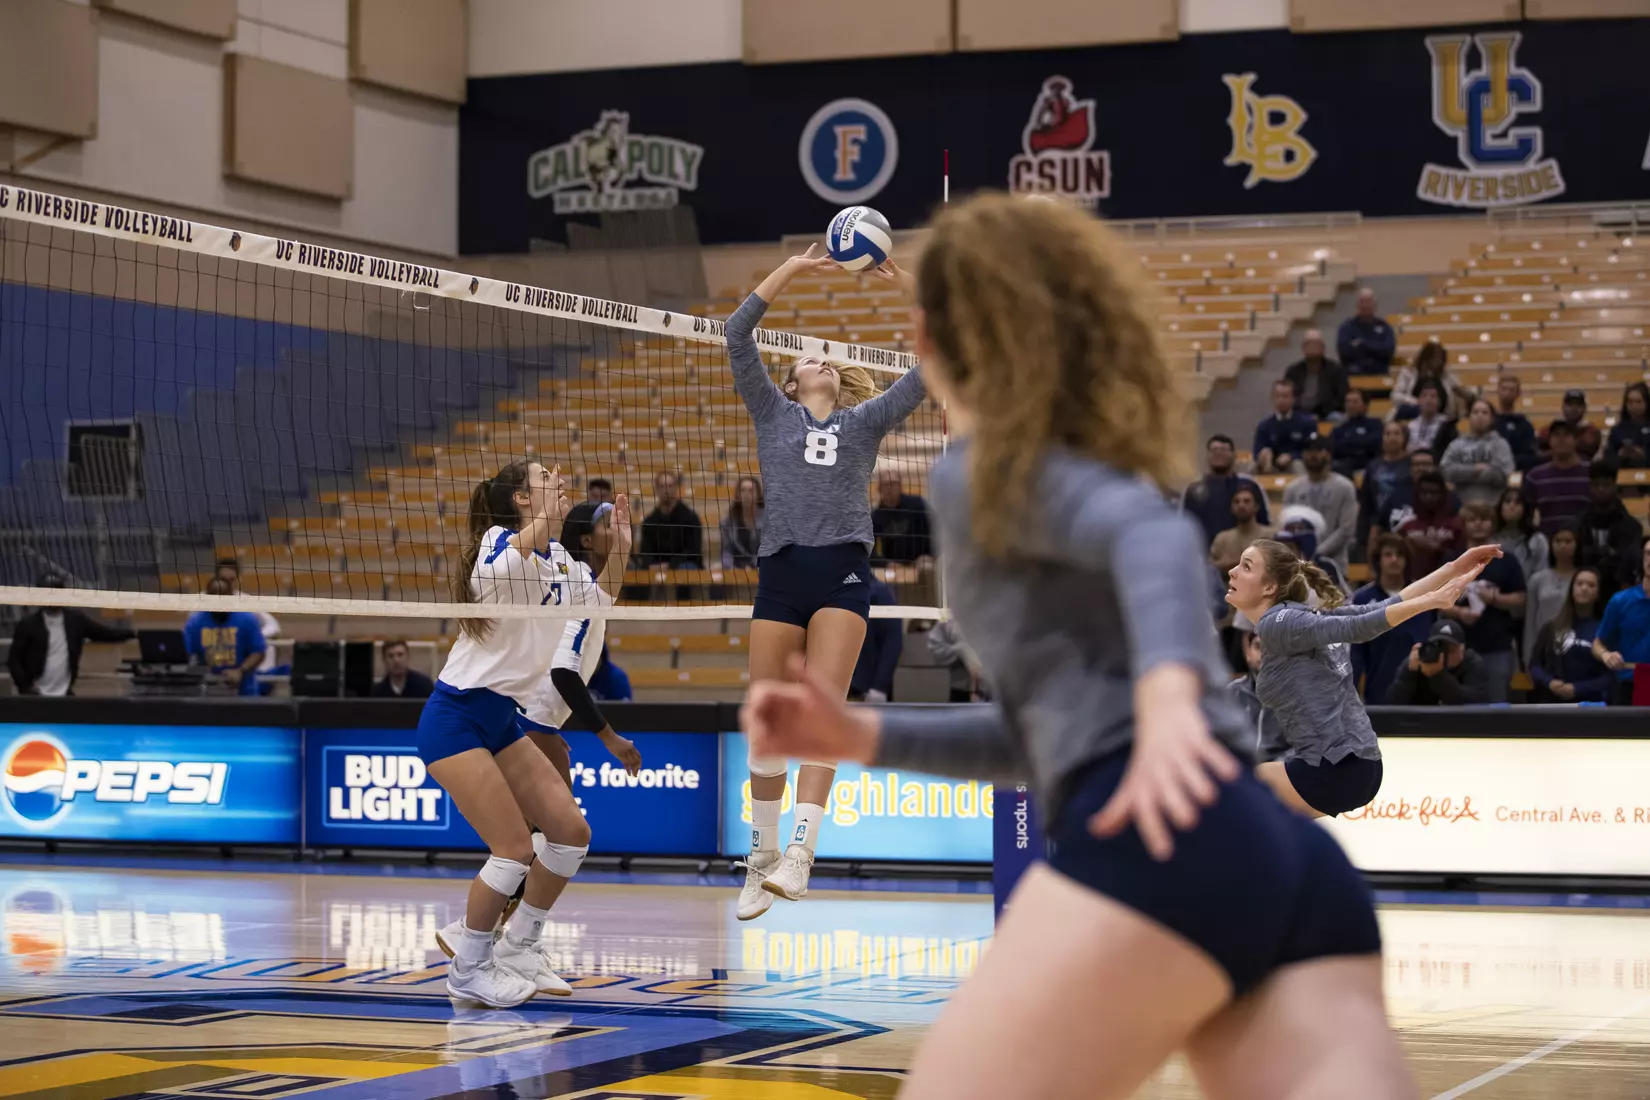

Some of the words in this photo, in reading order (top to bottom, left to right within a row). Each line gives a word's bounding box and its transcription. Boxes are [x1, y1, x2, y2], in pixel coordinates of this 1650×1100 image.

[532, 147, 587, 192] CAL
[627, 139, 698, 183] POLY
[832, 124, 868, 181] F
[1014, 156, 1104, 194] CSUN
[1423, 165, 1560, 201] RIVERSIDE
[16, 189, 99, 226] RIVERSIDE
[104, 206, 193, 243] VOLLEYBALL
[841, 208, 862, 242] molten
[275, 239, 293, 262] UC
[298, 243, 365, 275] RIVERSIDE
[369, 257, 440, 289] VOLLEYBALL
[505, 283, 520, 303] UC
[524, 286, 578, 313] RIVERSIDE
[581, 297, 638, 323] VOLLEYBALL
[693, 316, 707, 333] UC
[756, 327, 803, 351] VOLLEYBALL
[847, 344, 857, 360] UC
[860, 346, 896, 367] RIVERSIDE
[804, 431, 838, 466] 8
[60, 760, 227, 804] PEPSI
[344, 754, 427, 788] BUD
[599, 762, 699, 789] favorite
[329, 787, 442, 821] LIGHT
[1496, 806, 1563, 822] Central
[1569, 807, 1607, 823] Ave.
[1614, 806, 1626, 823] &
